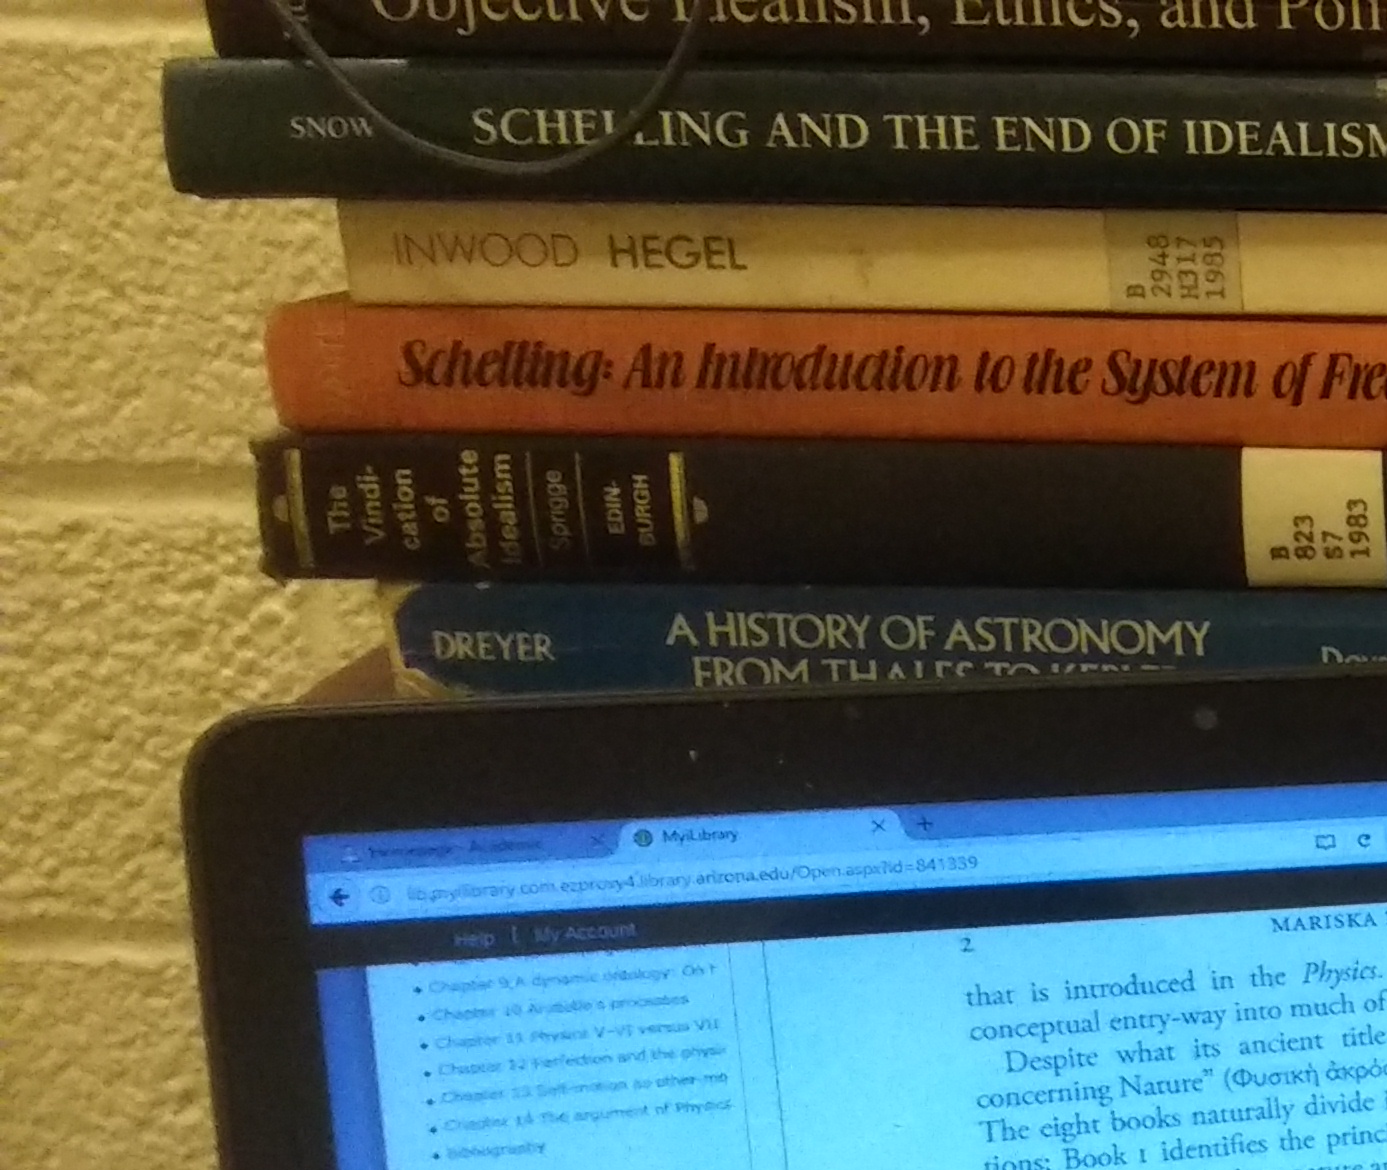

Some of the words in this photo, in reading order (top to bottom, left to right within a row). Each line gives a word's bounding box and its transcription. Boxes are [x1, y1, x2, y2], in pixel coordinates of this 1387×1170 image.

[1160, 0, 1257, 30] and
[289, 115, 374, 140] SNOW
[766, 111, 869, 150] AND
[883, 113, 980, 152] THE
[995, 116, 1091, 154] END
[1107, 117, 1167, 155] OF
[391, 232, 578, 269] INWOOD
[609, 234, 747, 272] HEGEL
[1150, 234, 1171, 299] 2948
[1179, 237, 1198, 299] H317
[1204, 237, 1225, 299] 1985
[1127, 284, 1146, 299] B
[400, 339, 613, 396] Schelling:
[623, 342, 687, 390] An
[695, 343, 960, 394] Introduction
[974, 348, 1014, 394] to
[1023, 347, 1093, 395] the
[1102, 348, 1257, 404] System
[1272, 352, 1317, 407] of
[327, 484, 349, 535] The
[393, 468, 421, 550] cation
[458, 449, 491, 569] Absolute
[492, 453, 522, 566] Idealism
[1347, 498, 1371, 560] 1983
[1295, 514, 1315, 560] 823
[432, 630, 555, 661] DREYER
[666, 613, 697, 645] A
[705, 611, 870, 650] HISTORY
[880, 614, 935, 650] OF
[943, 617, 1210, 656] ASTRONOMY
[693, 656, 808, 687] FROM
[536, 926, 561, 944] My
[565, 922, 637, 942] Account
[960, 938, 974, 952] 2
[1271, 912, 1377, 933] MARISKA
[965, 982, 1014, 1007] that
[1064, 970, 1196, 1001] introduced
[1211, 970, 1234, 991] in
[1249, 964, 1286, 987] the
[1303, 959, 1383, 990] Physics.
[969, 1011, 1100, 1044] conceptual
[1110, 1007, 1226, 1036] entry-way
[1236, 998, 1282, 1023] into
[1290, 993, 1354, 1018] much
[1006, 1046, 1099, 1076] Despite
[1117, 1041, 1175, 1064] what
[1193, 1038, 1221, 1060] its
[1239, 1033, 1323, 1056] ancient
[1342, 1024, 1386, 1047] title
